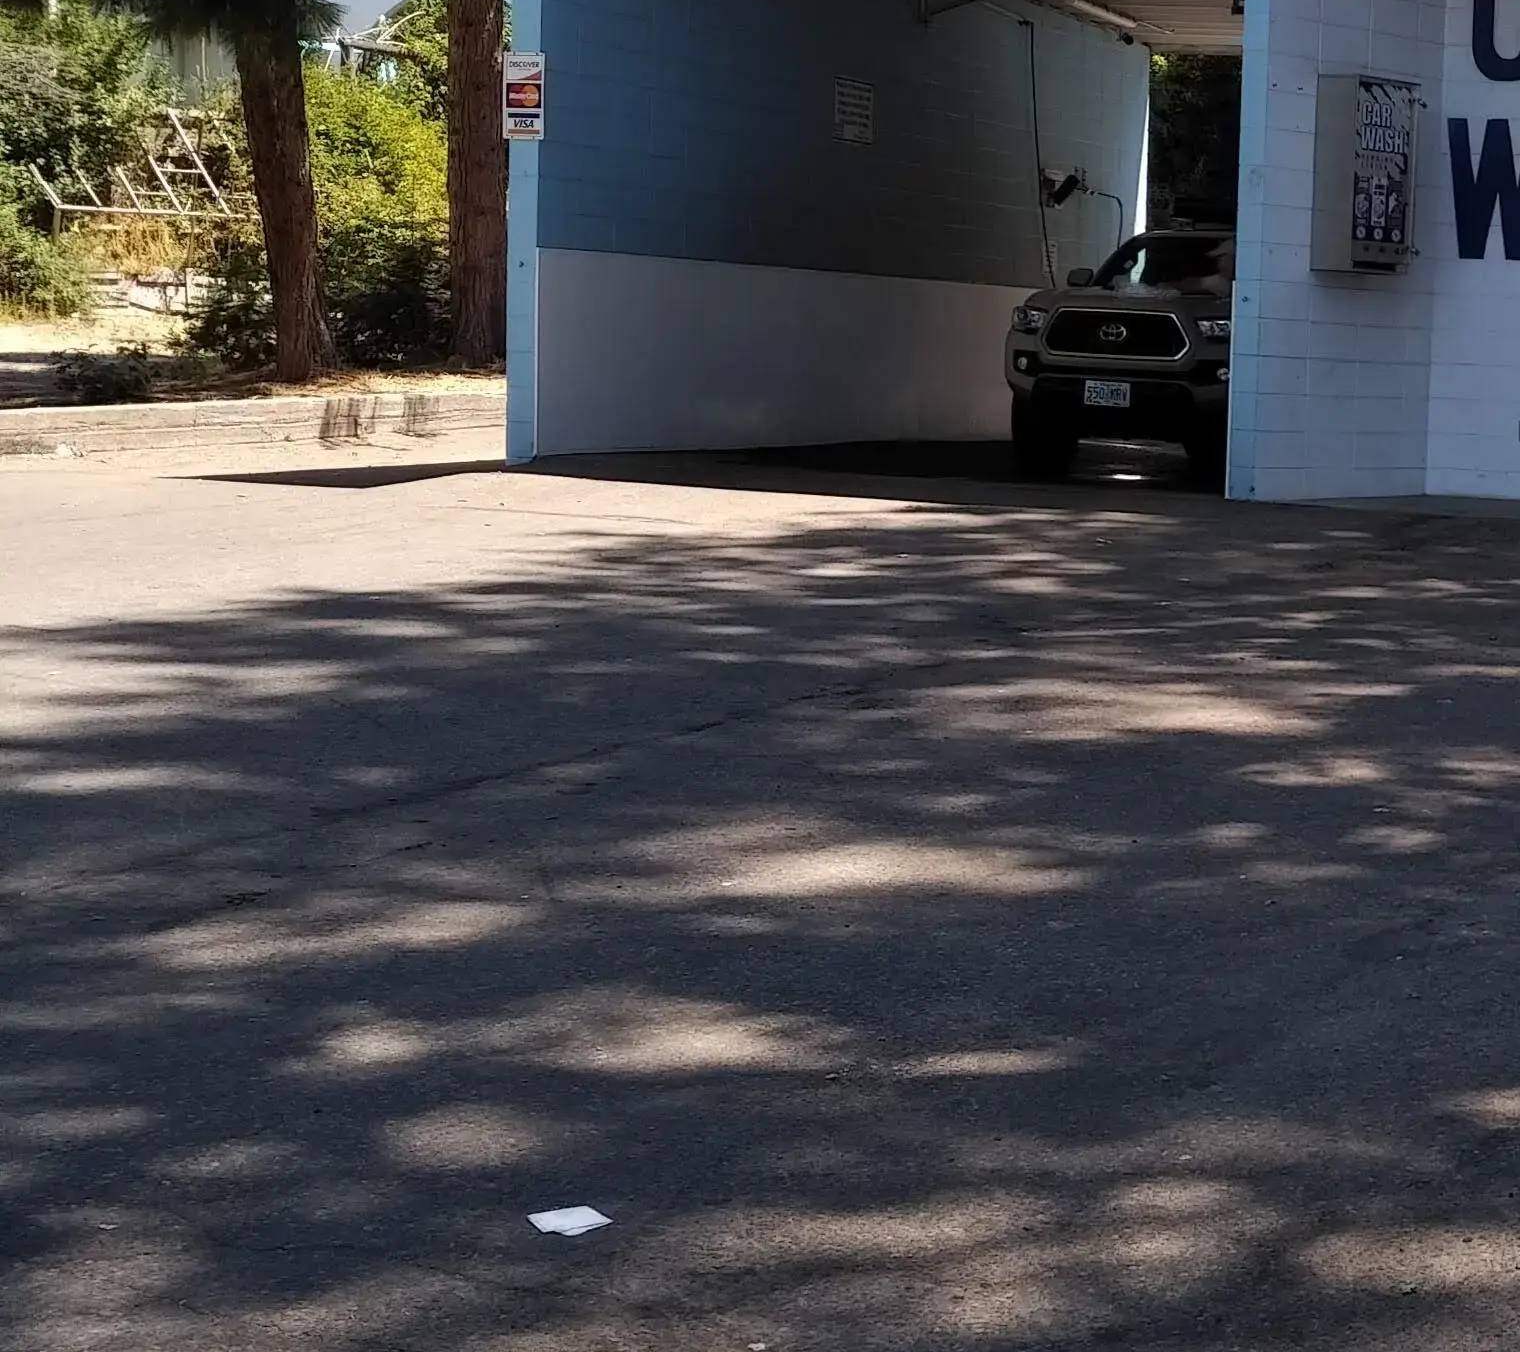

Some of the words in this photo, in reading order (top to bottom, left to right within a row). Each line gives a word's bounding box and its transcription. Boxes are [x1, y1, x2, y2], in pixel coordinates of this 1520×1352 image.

[513, 119, 535, 128] VISA
[1362, 101, 1392, 127] CAR
[1361, 126, 1405, 154] WASH
